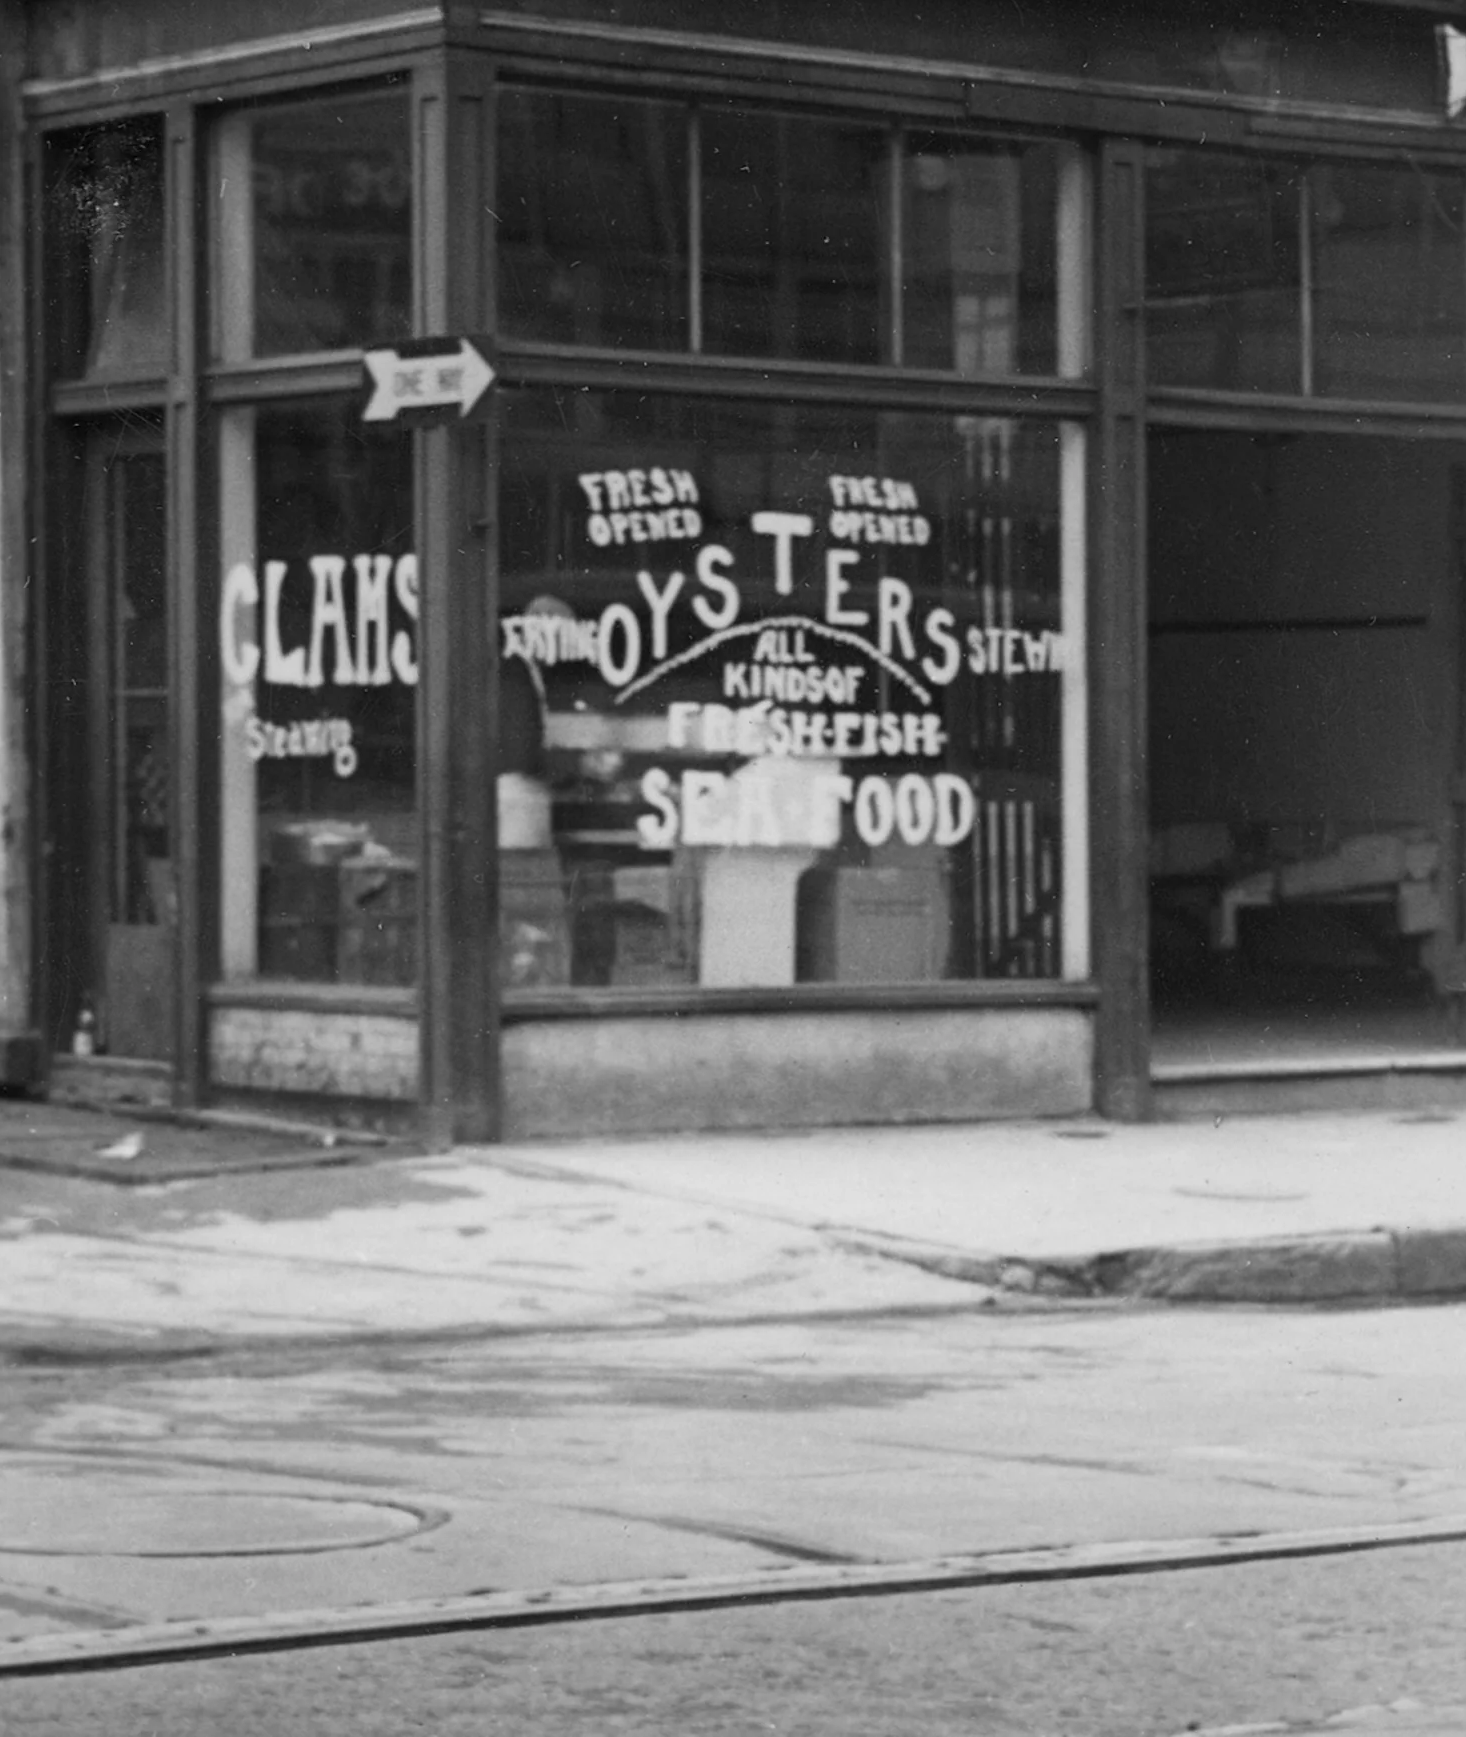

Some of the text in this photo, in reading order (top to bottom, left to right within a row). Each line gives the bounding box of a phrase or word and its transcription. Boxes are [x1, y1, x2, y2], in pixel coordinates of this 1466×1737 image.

[579, 467, 699, 512] FRESH
[829, 474, 919, 511] FRESH
[588, 508, 703, 547] OPENED
[829, 508, 931, 546] OPENED
[599, 510, 961, 687] OYSTERS
[220, 553, 419, 687] CLAMS
[753, 629, 816, 663] ALL
